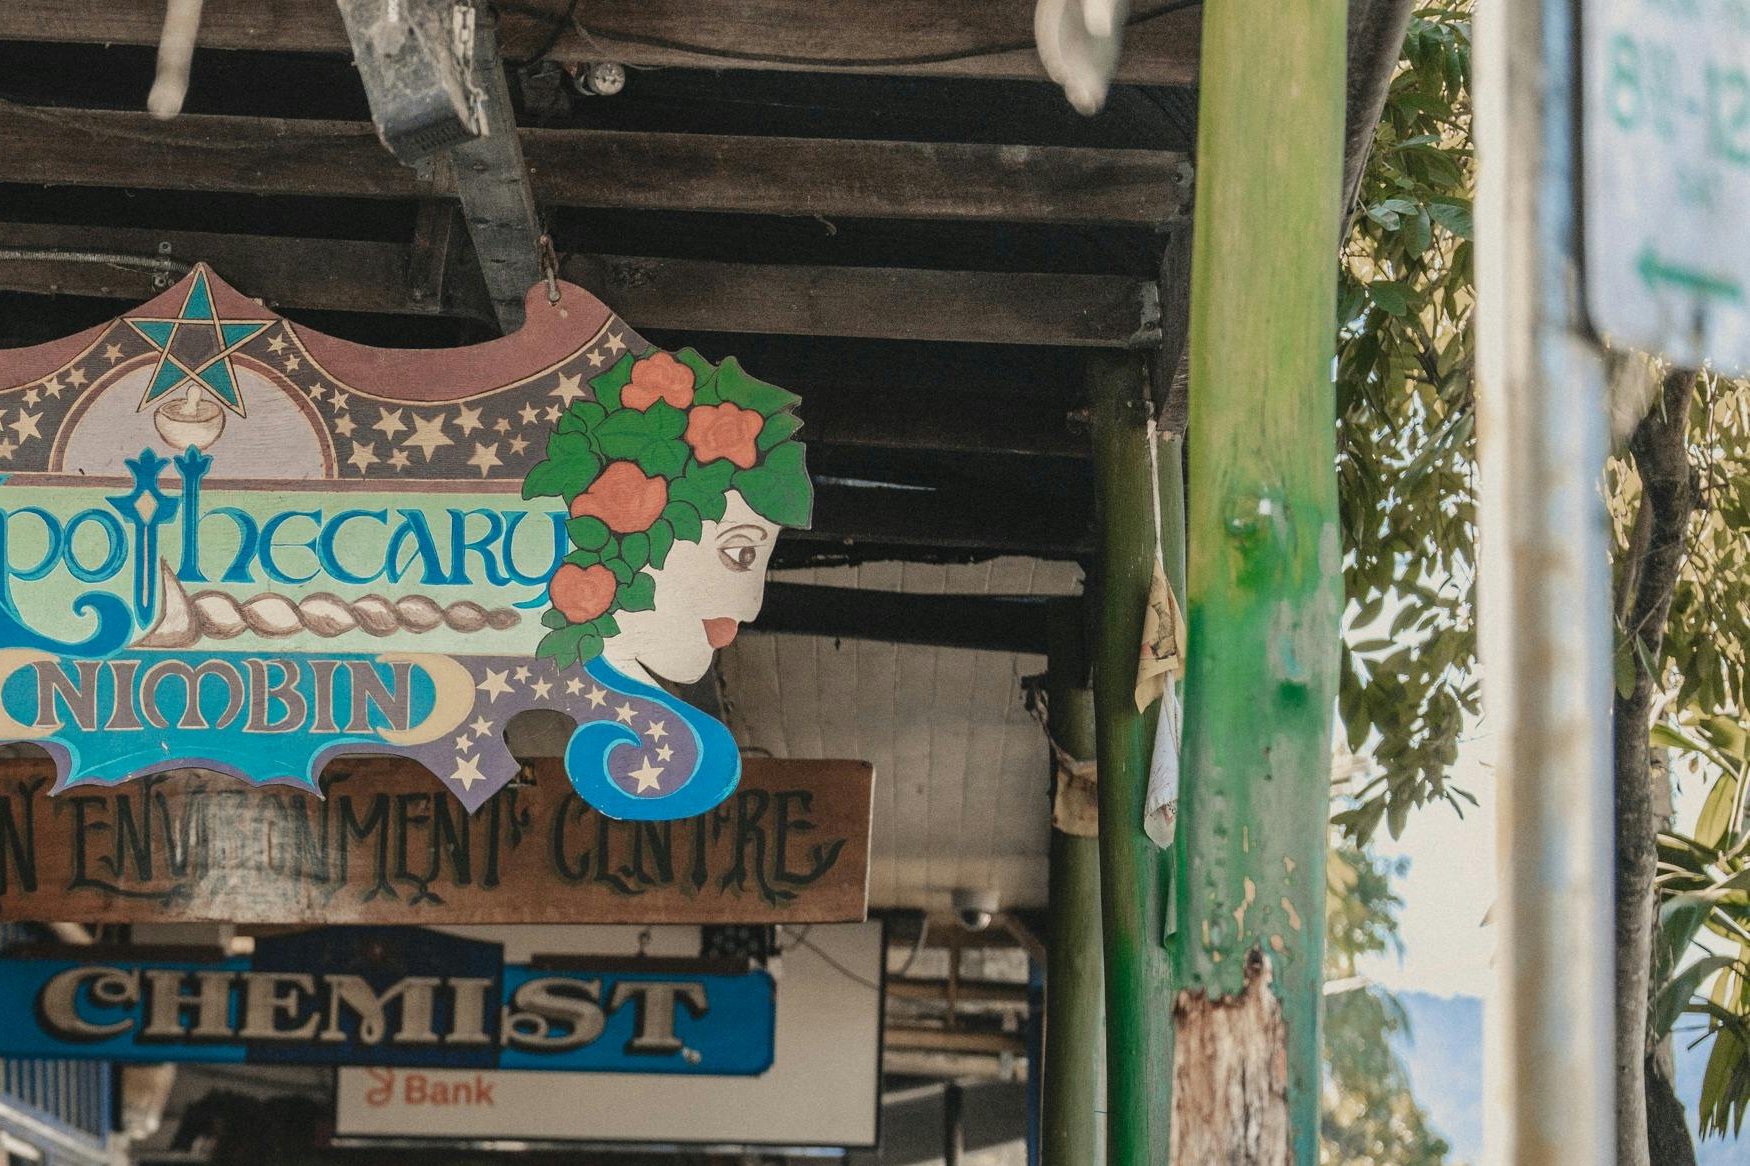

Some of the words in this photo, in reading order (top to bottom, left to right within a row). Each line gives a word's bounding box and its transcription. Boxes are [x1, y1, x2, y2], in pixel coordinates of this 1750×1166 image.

[33, 657, 413, 735] NIMBIN
[36, 965, 708, 1057] CHEMIST
[403, 1073, 496, 1106] Bank
